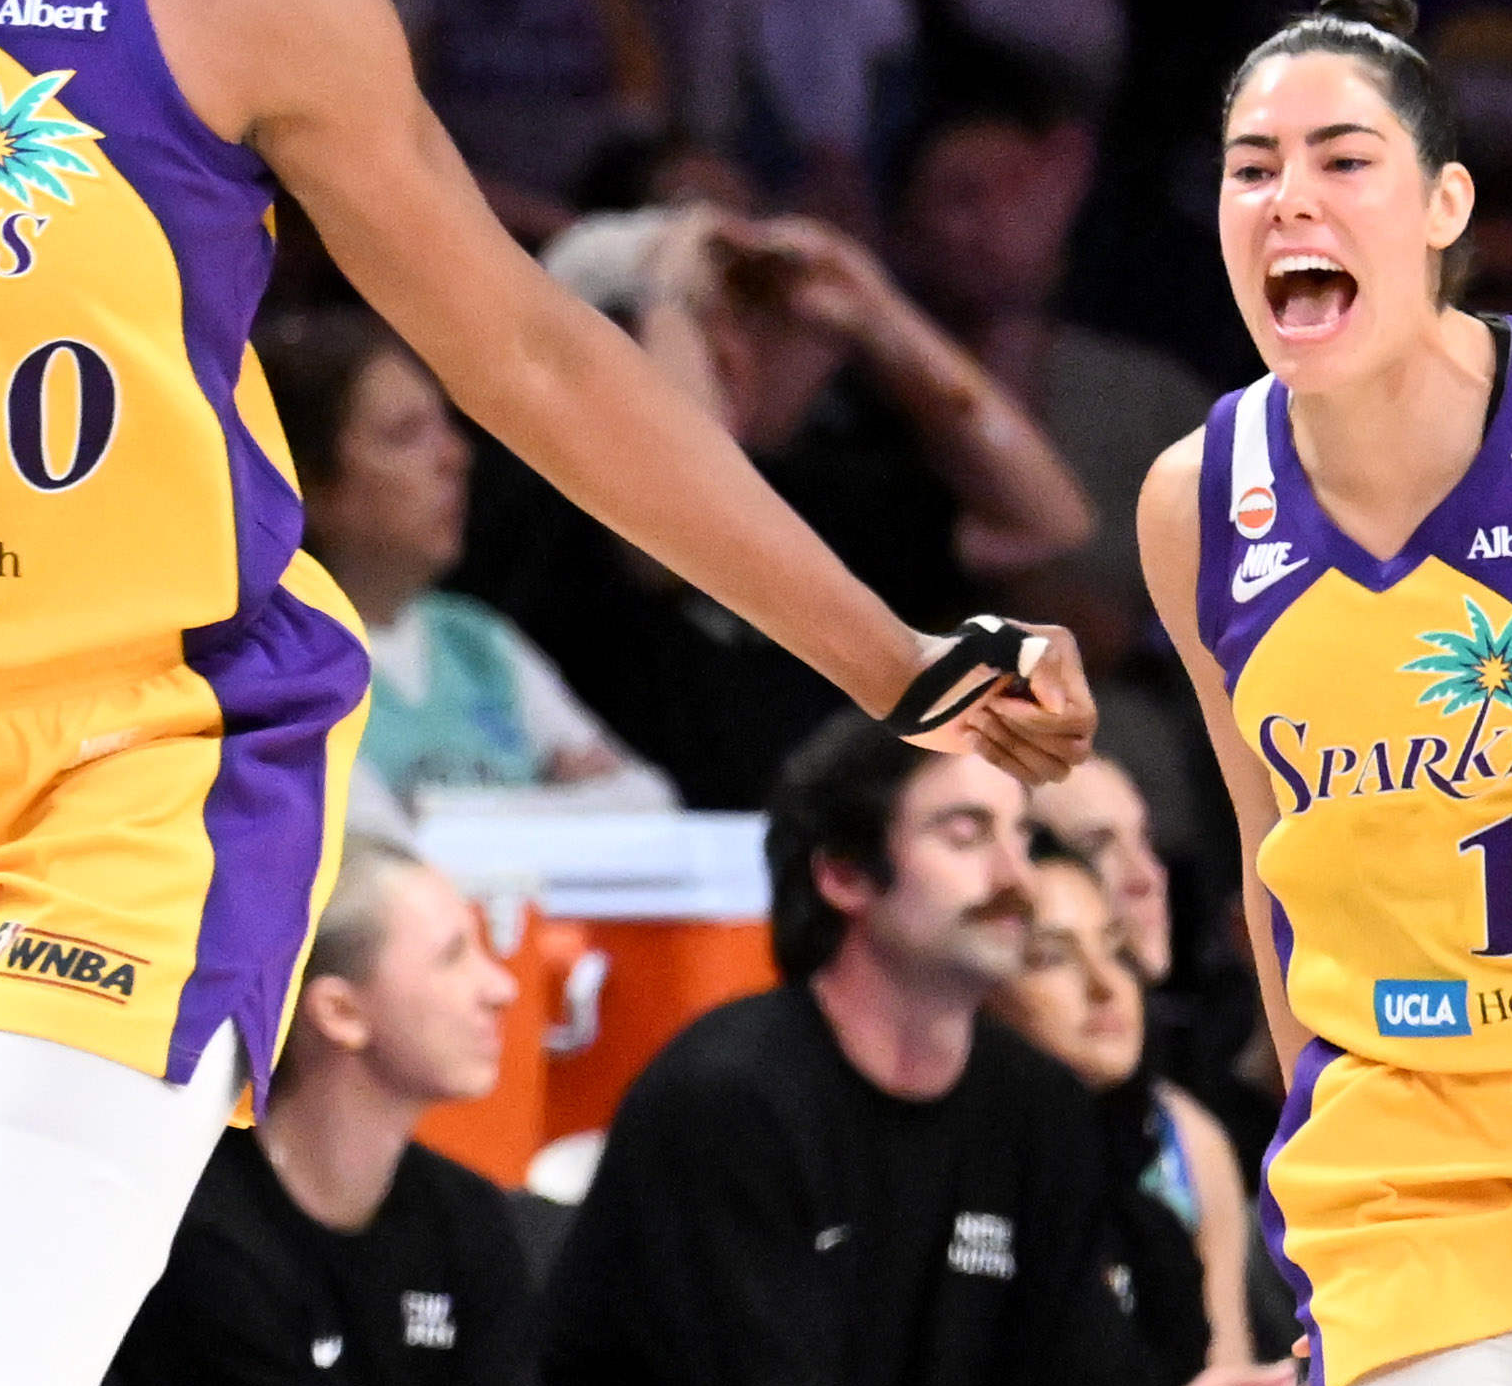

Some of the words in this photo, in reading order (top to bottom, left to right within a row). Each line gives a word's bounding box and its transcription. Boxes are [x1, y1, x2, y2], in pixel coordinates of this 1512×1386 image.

[1242, 542, 1293, 578] NIKE
[7, 936, 135, 997] WNBA
[1385, 992, 1455, 1027] UCLA
